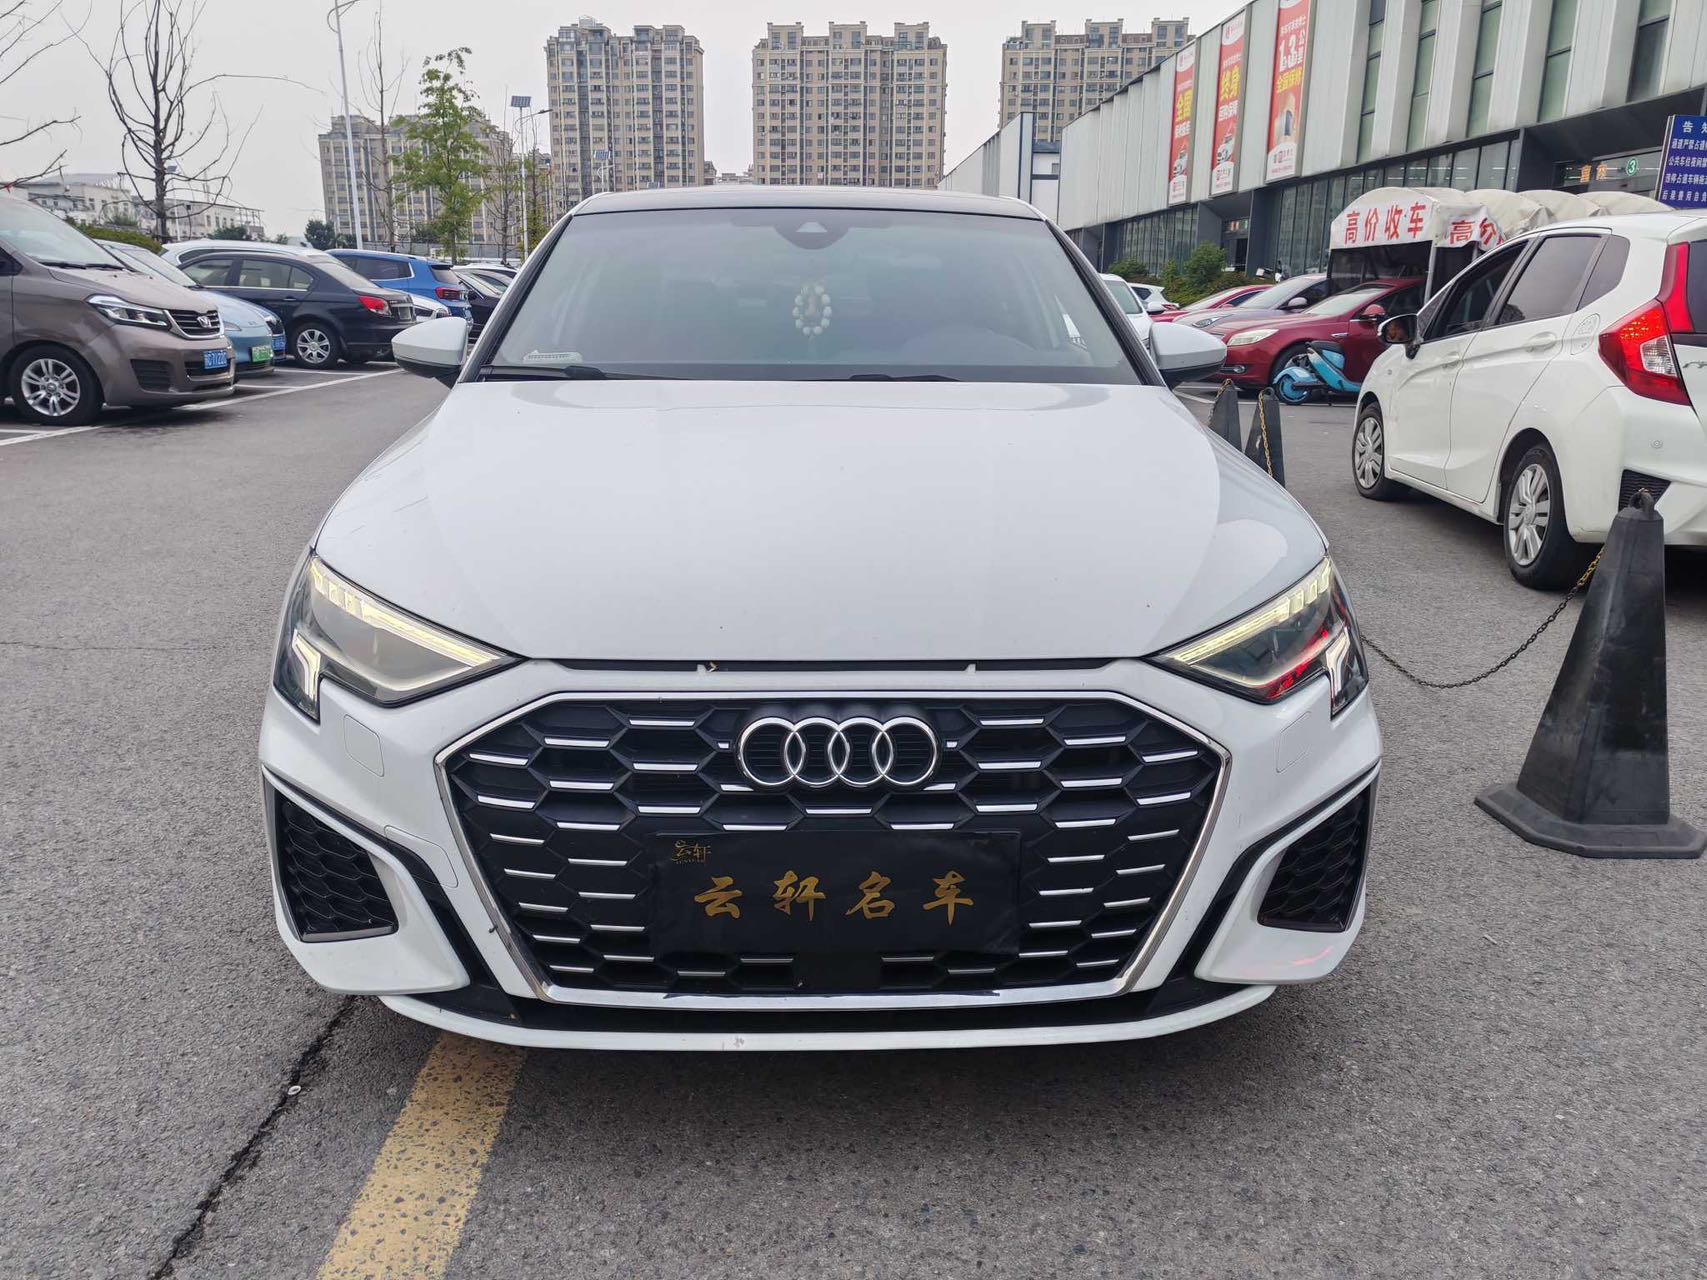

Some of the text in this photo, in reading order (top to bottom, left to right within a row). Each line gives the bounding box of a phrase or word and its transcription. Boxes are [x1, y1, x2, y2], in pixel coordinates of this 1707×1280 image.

[1344, 202, 1426, 245] 高价收车
[694, 870, 974, 926] 云轩名车
